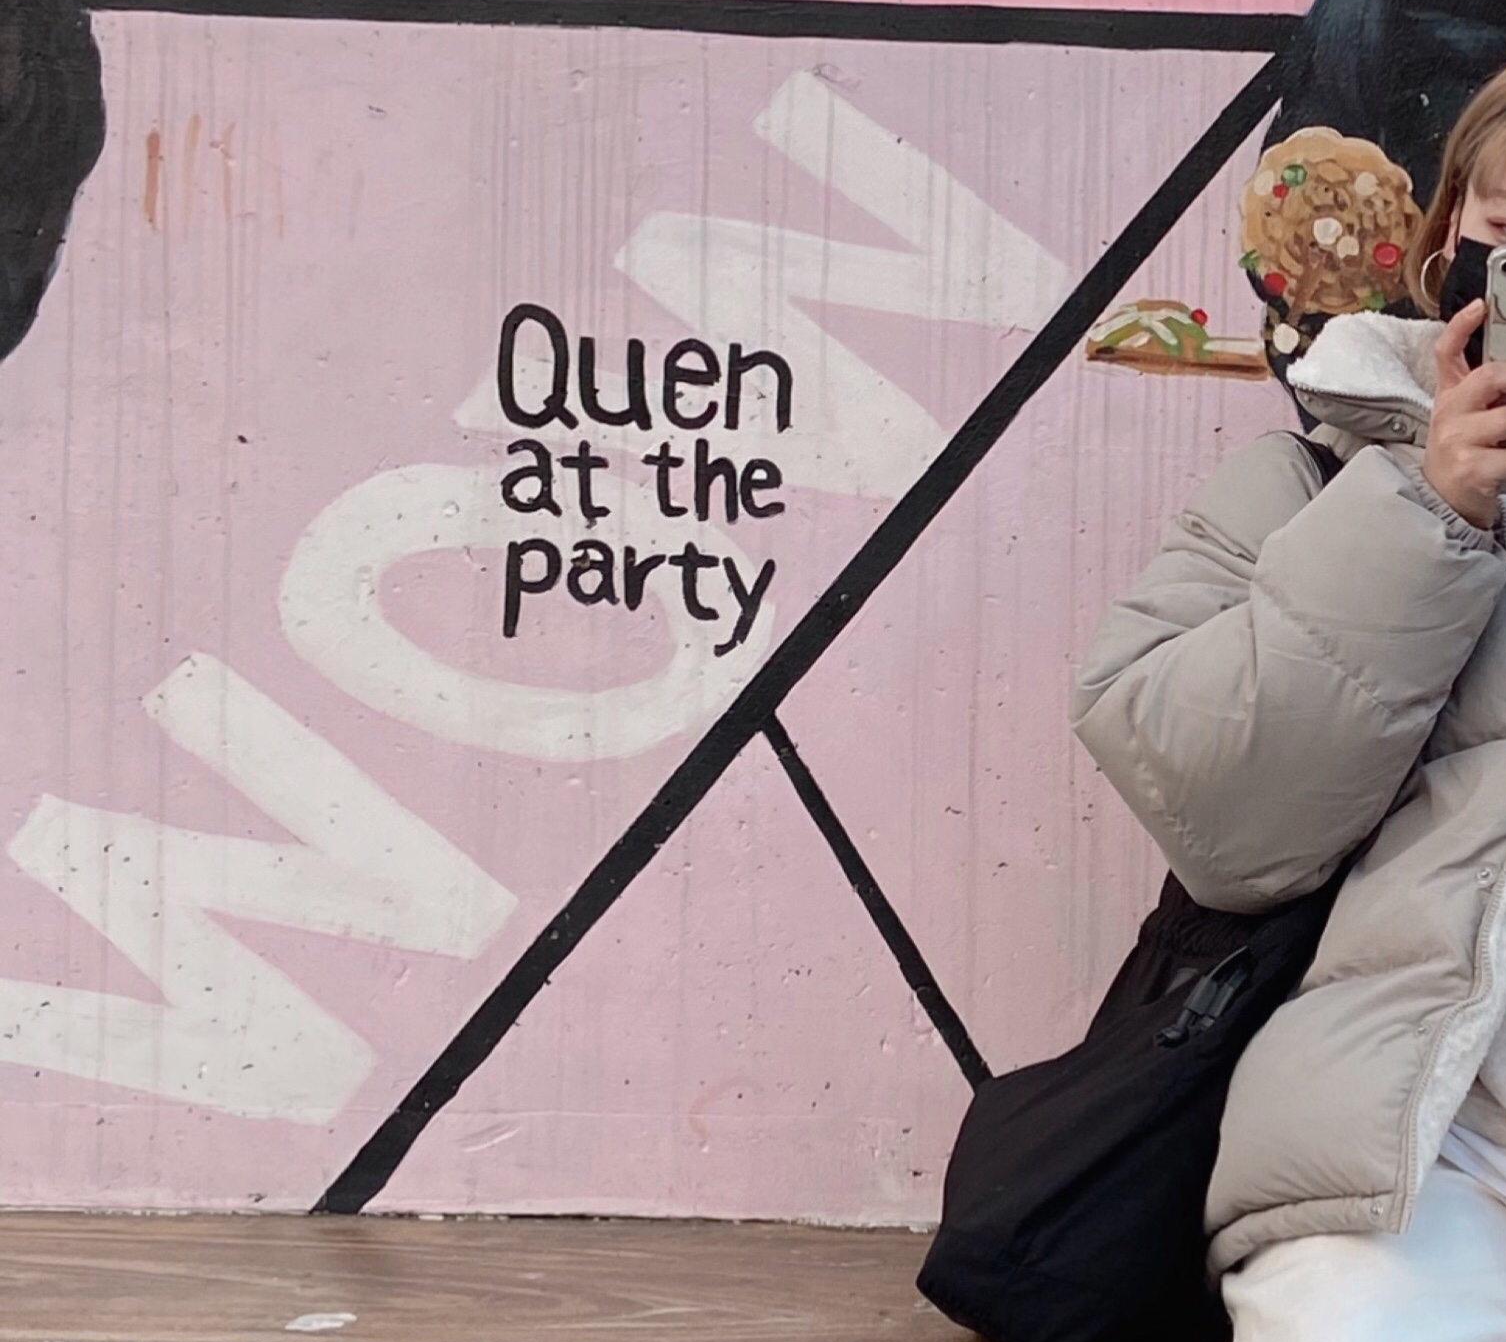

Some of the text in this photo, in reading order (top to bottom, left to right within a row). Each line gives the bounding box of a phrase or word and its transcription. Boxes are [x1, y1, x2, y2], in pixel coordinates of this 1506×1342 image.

[497, 303, 793, 433] Quen
[501, 438, 785, 523] at the
[502, 538, 776, 658] party
